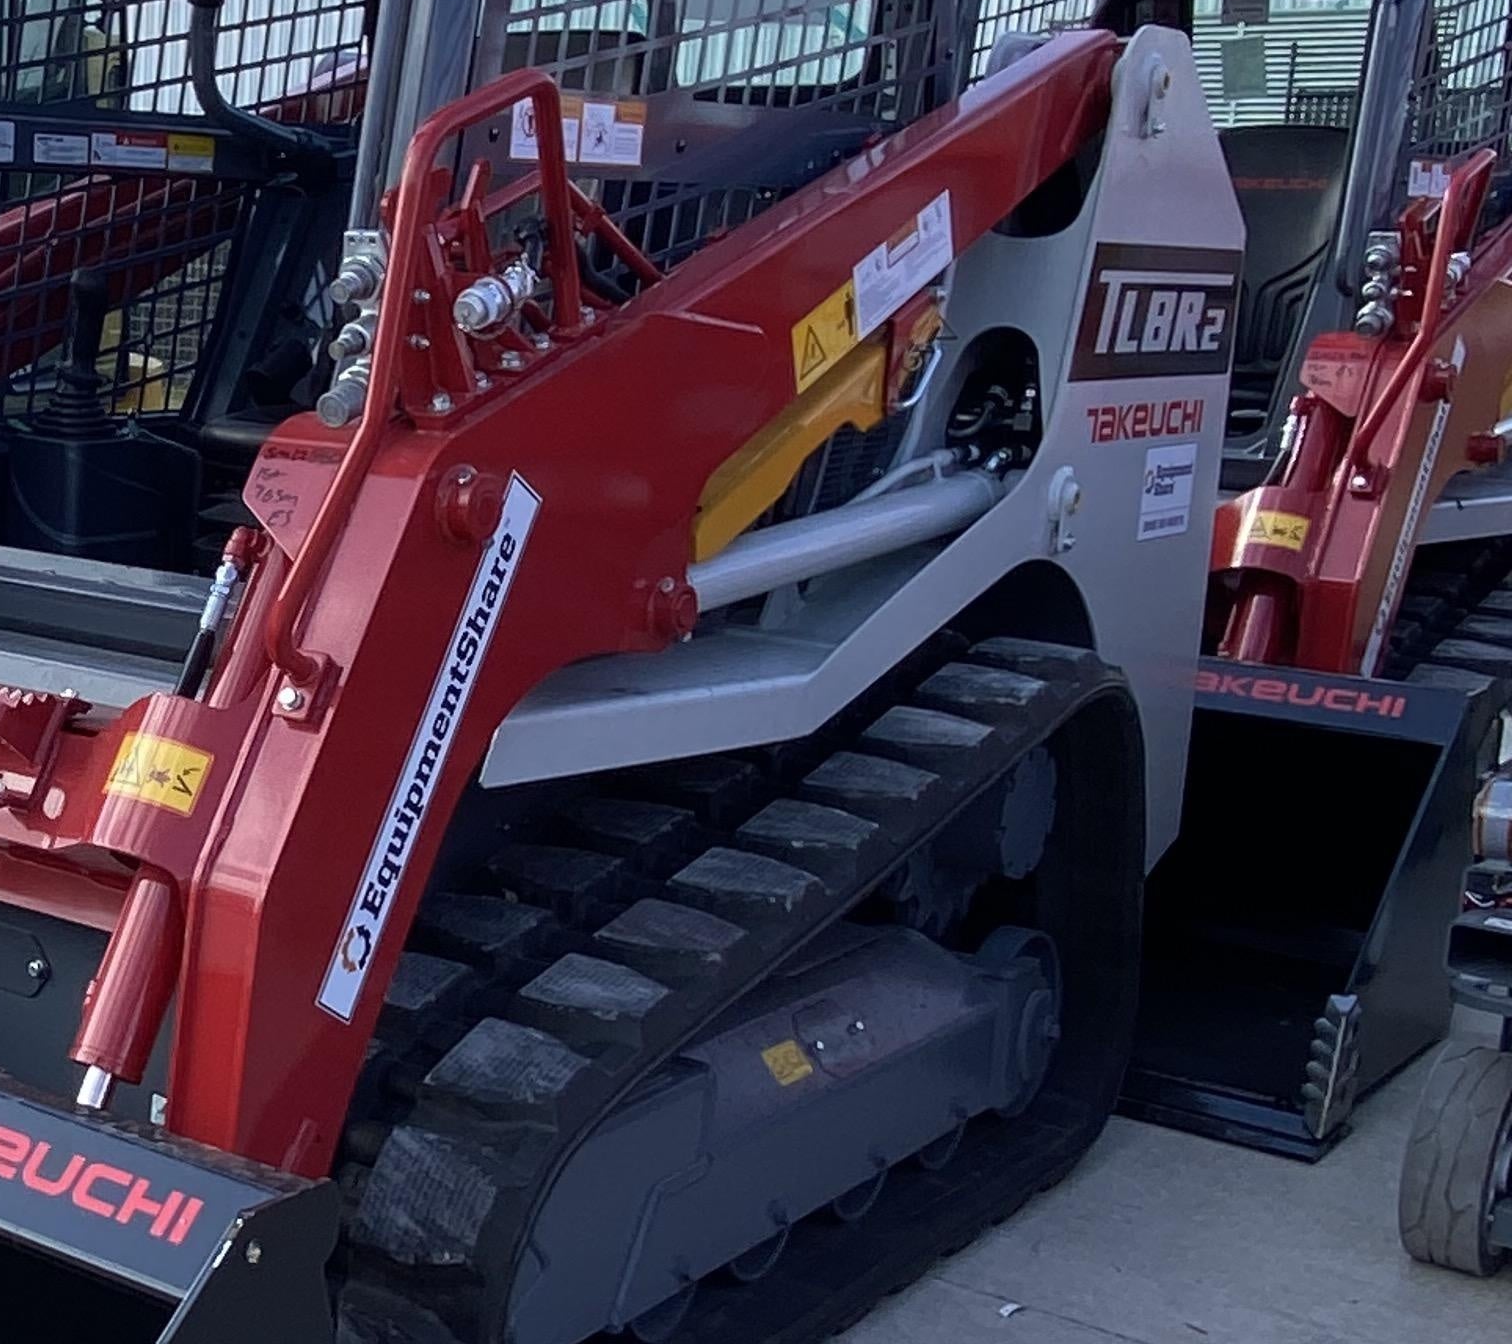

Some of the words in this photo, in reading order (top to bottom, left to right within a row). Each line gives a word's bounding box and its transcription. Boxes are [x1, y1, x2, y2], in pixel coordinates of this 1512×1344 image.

[1086, 399, 1204, 443] TAKEUCHI
[1195, 670, 1406, 718] AKEUCHI
[359, 532, 516, 920] EquipmentShare
